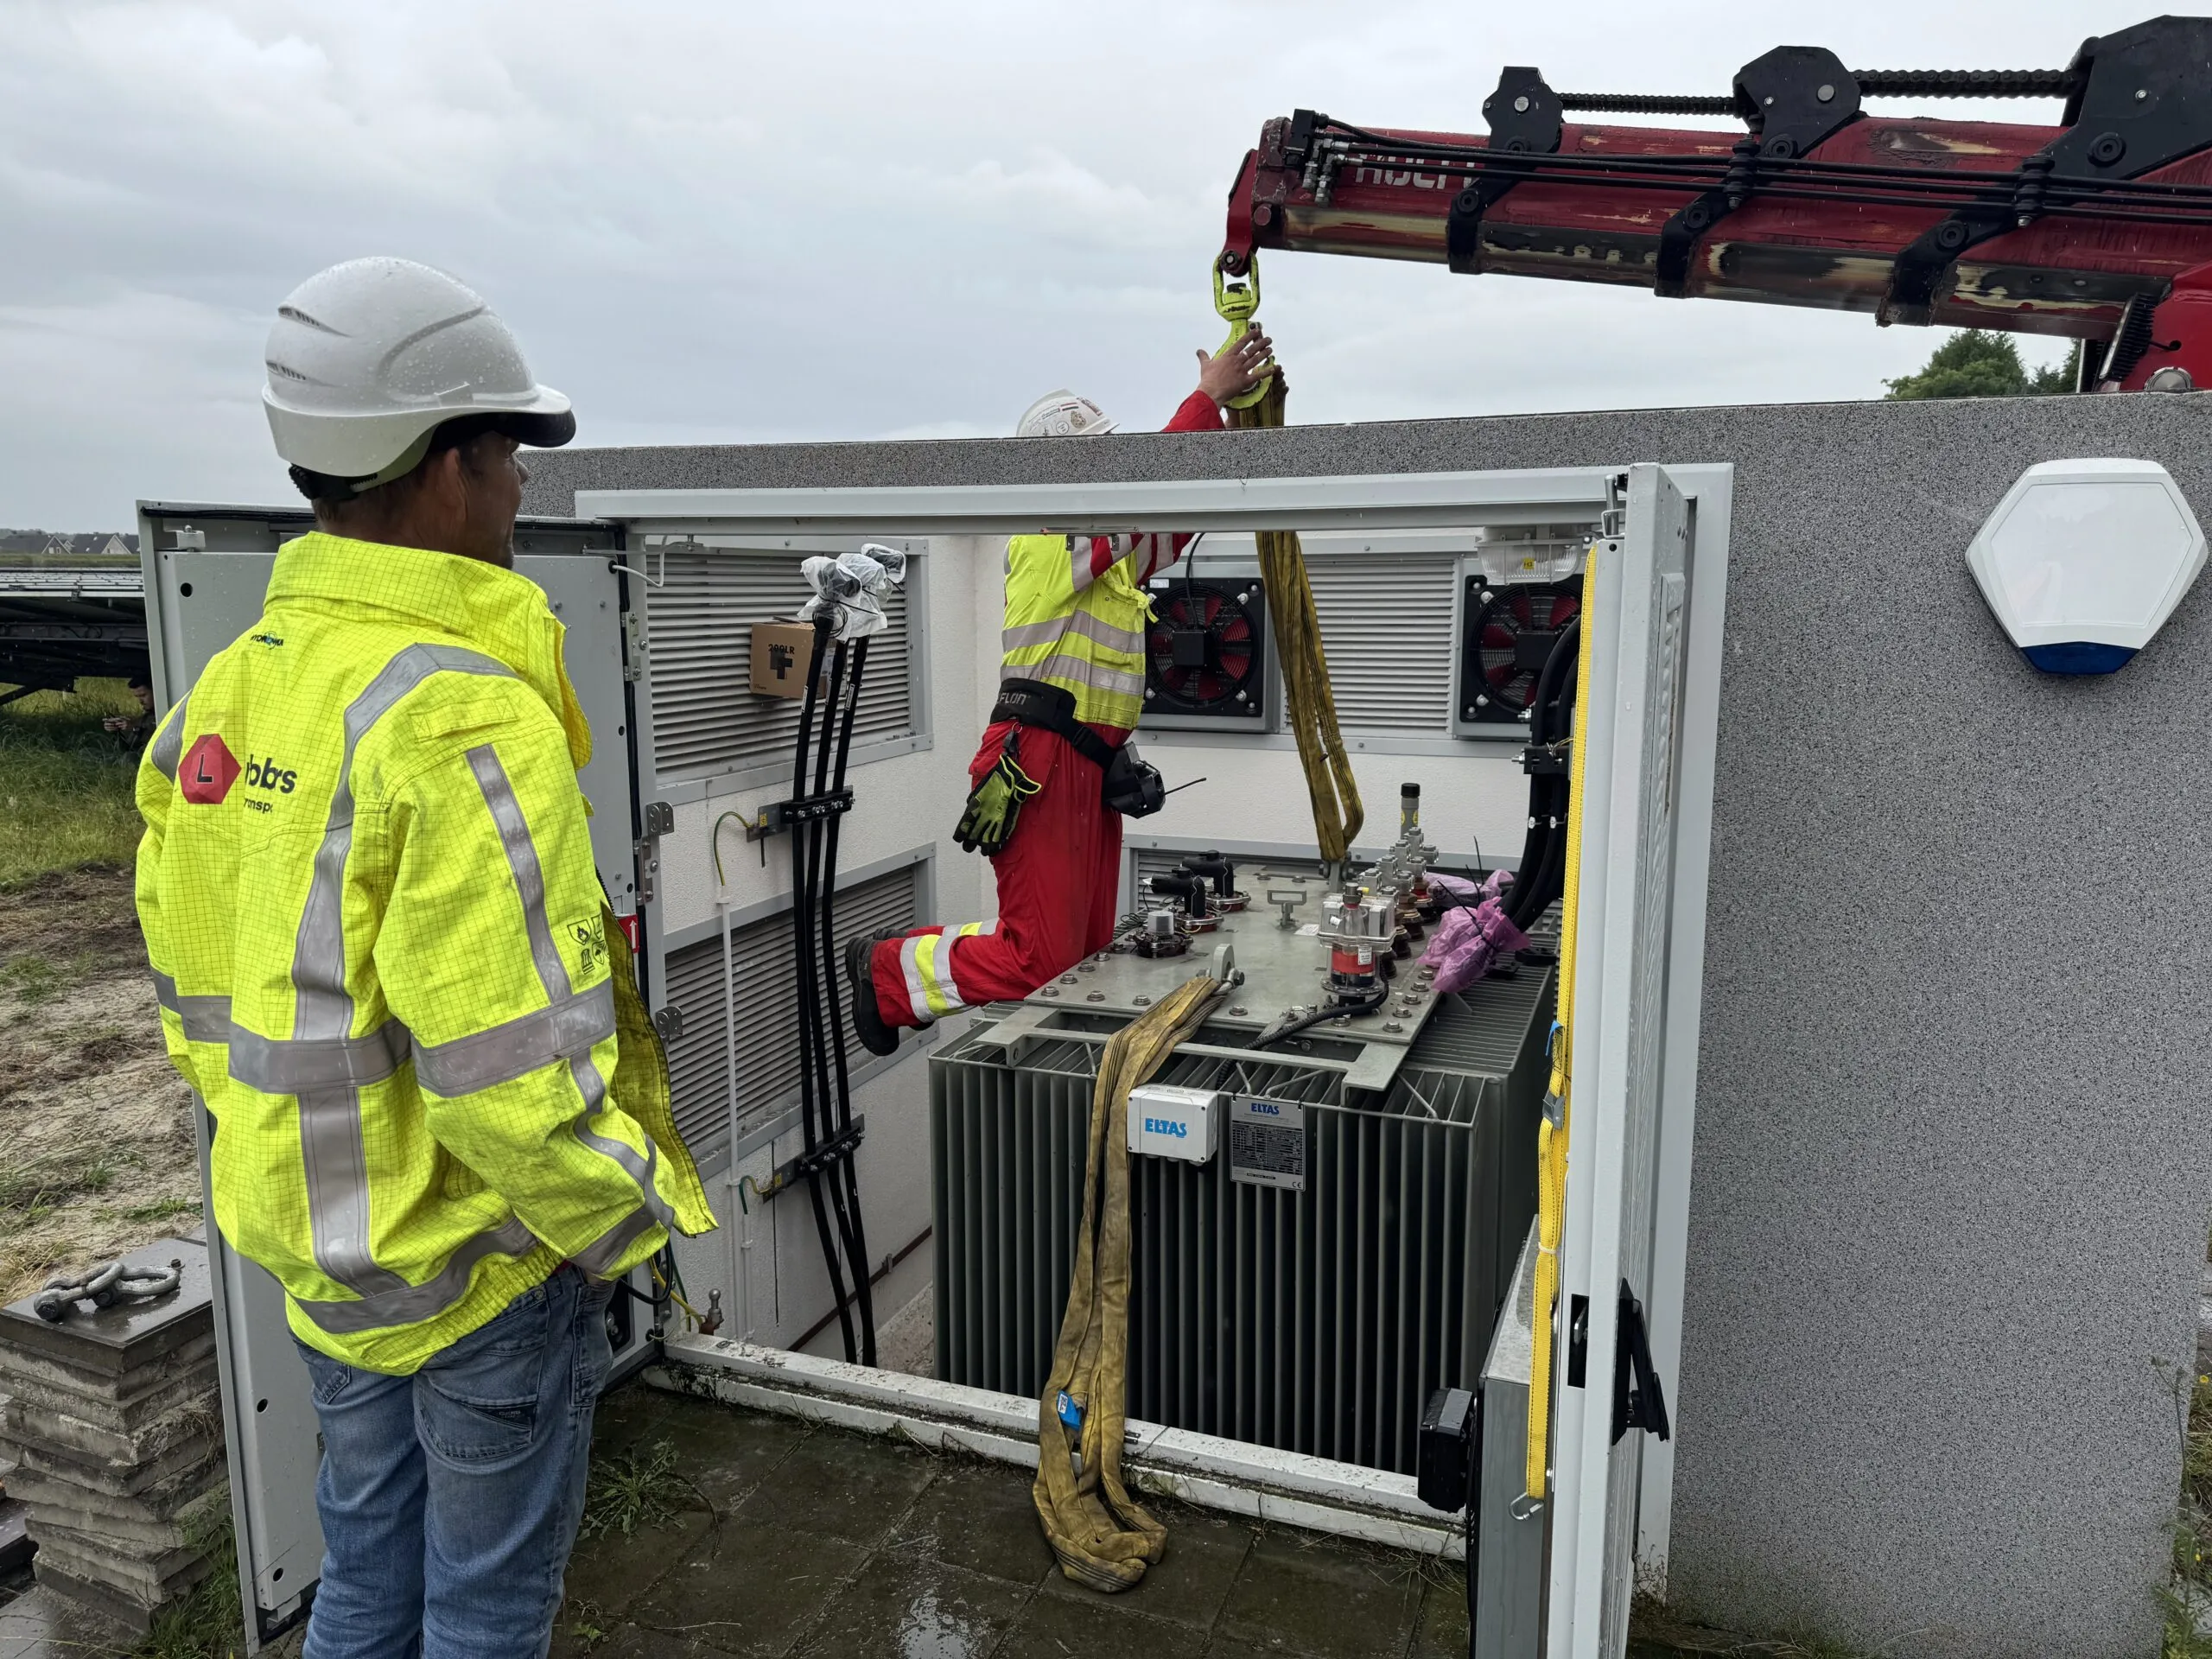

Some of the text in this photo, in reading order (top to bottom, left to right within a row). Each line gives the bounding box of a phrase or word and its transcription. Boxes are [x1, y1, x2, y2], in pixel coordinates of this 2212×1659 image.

[997, 692, 1027, 705] FLON
[196, 753, 214, 784] L
[1251, 1103, 1280, 1116] ELTAS
[1145, 1117, 1187, 1139] ELTAS
